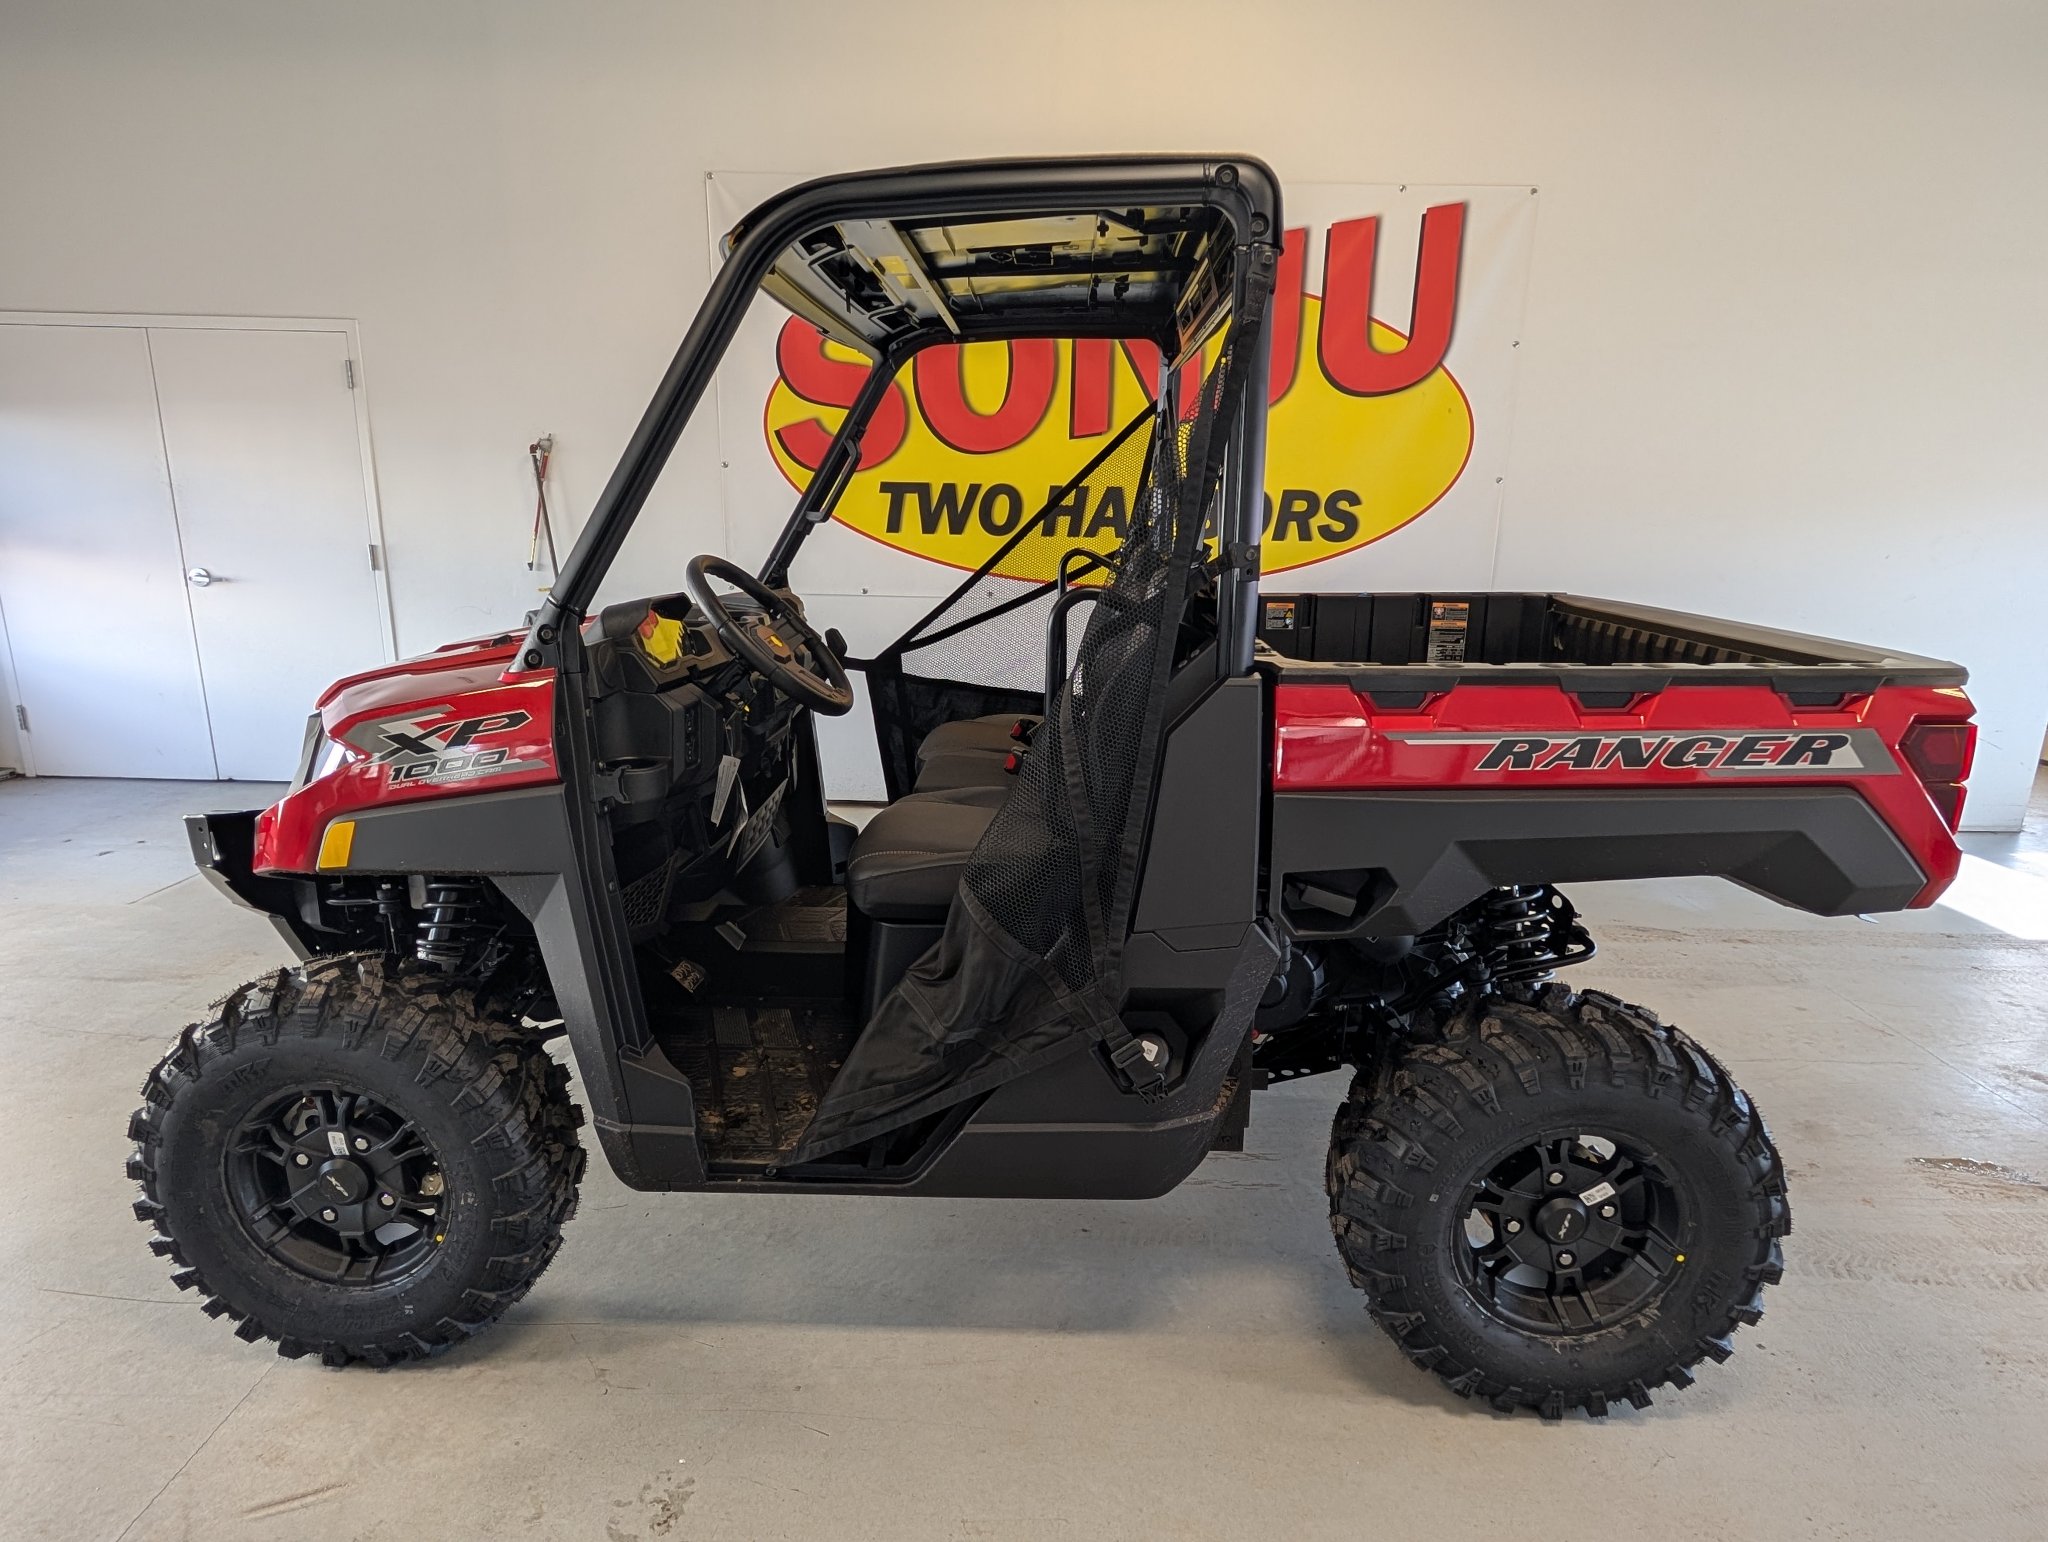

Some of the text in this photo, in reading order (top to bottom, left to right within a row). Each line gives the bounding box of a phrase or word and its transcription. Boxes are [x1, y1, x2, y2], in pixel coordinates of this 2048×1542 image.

[879, 481, 1023, 536] TWO
[365, 709, 533, 768] XP
[1473, 733, 1852, 770] RANGER
[388, 748, 510, 783] 1000
[388, 780, 417, 790] DUAL
[477, 766, 502, 776] CAM
